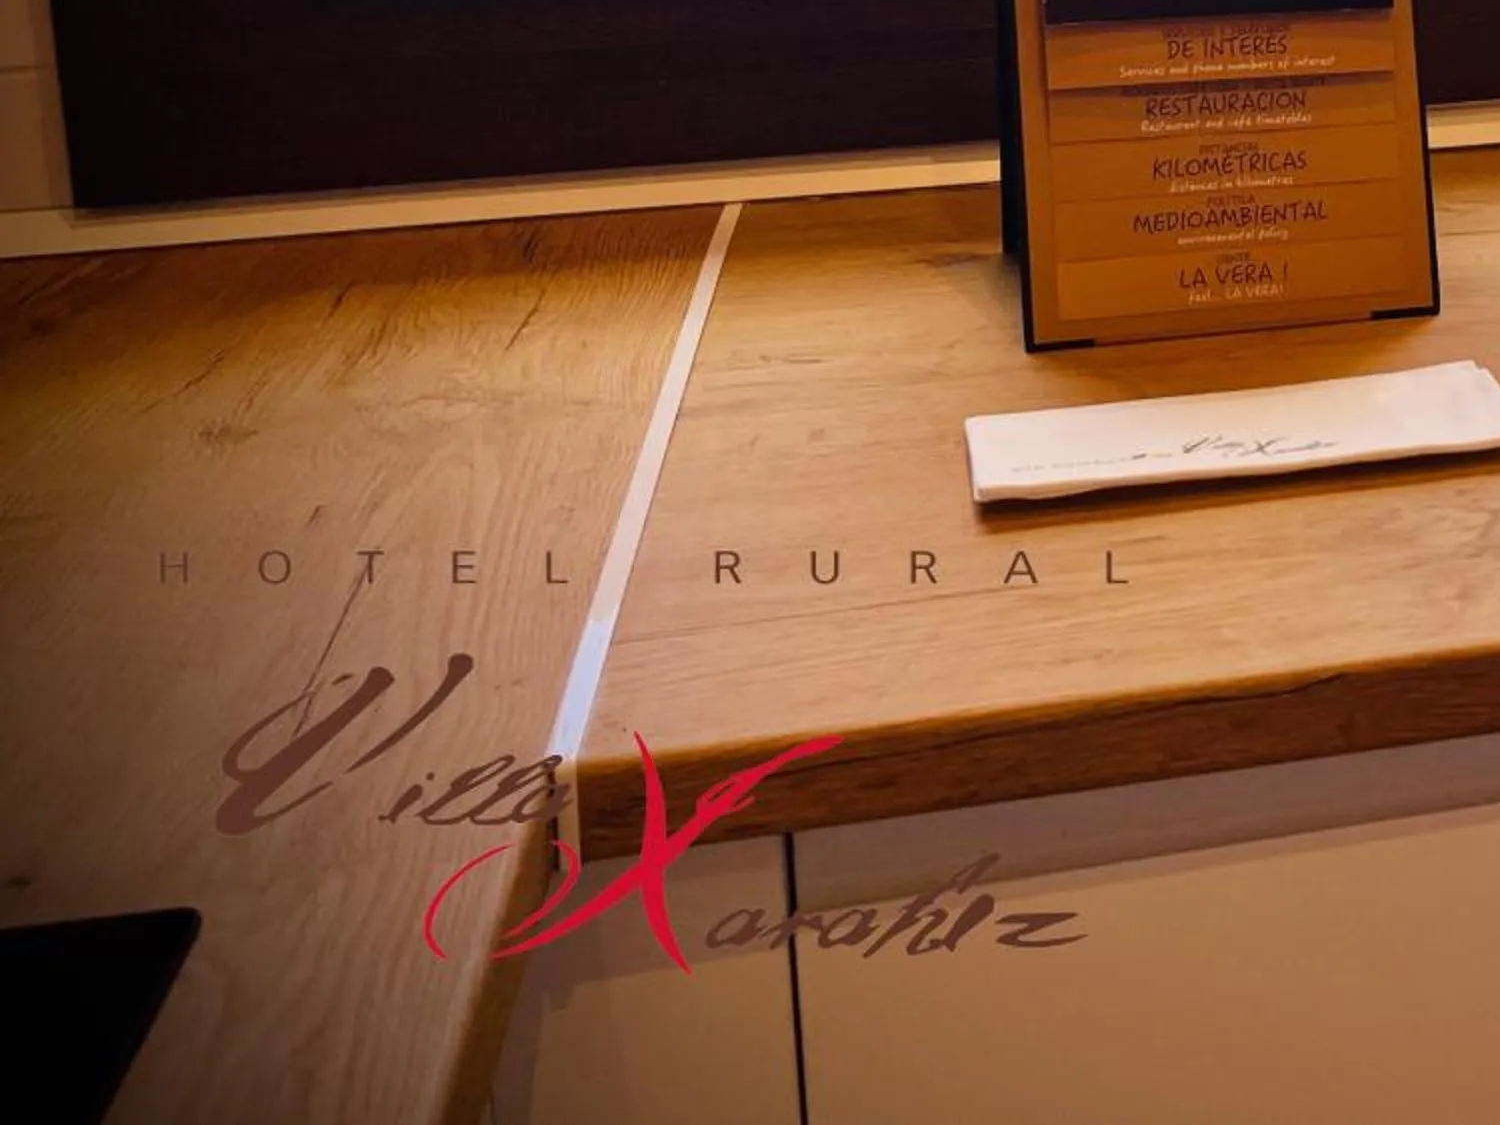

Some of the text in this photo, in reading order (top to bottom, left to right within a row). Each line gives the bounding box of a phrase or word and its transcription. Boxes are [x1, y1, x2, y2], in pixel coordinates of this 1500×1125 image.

[1167, 40, 1195, 61] DE
[1133, 199, 1329, 234] MEDIOAMBIENTAL
[1179, 266, 1209, 289] LA
[1215, 261, 1273, 285] VERA
